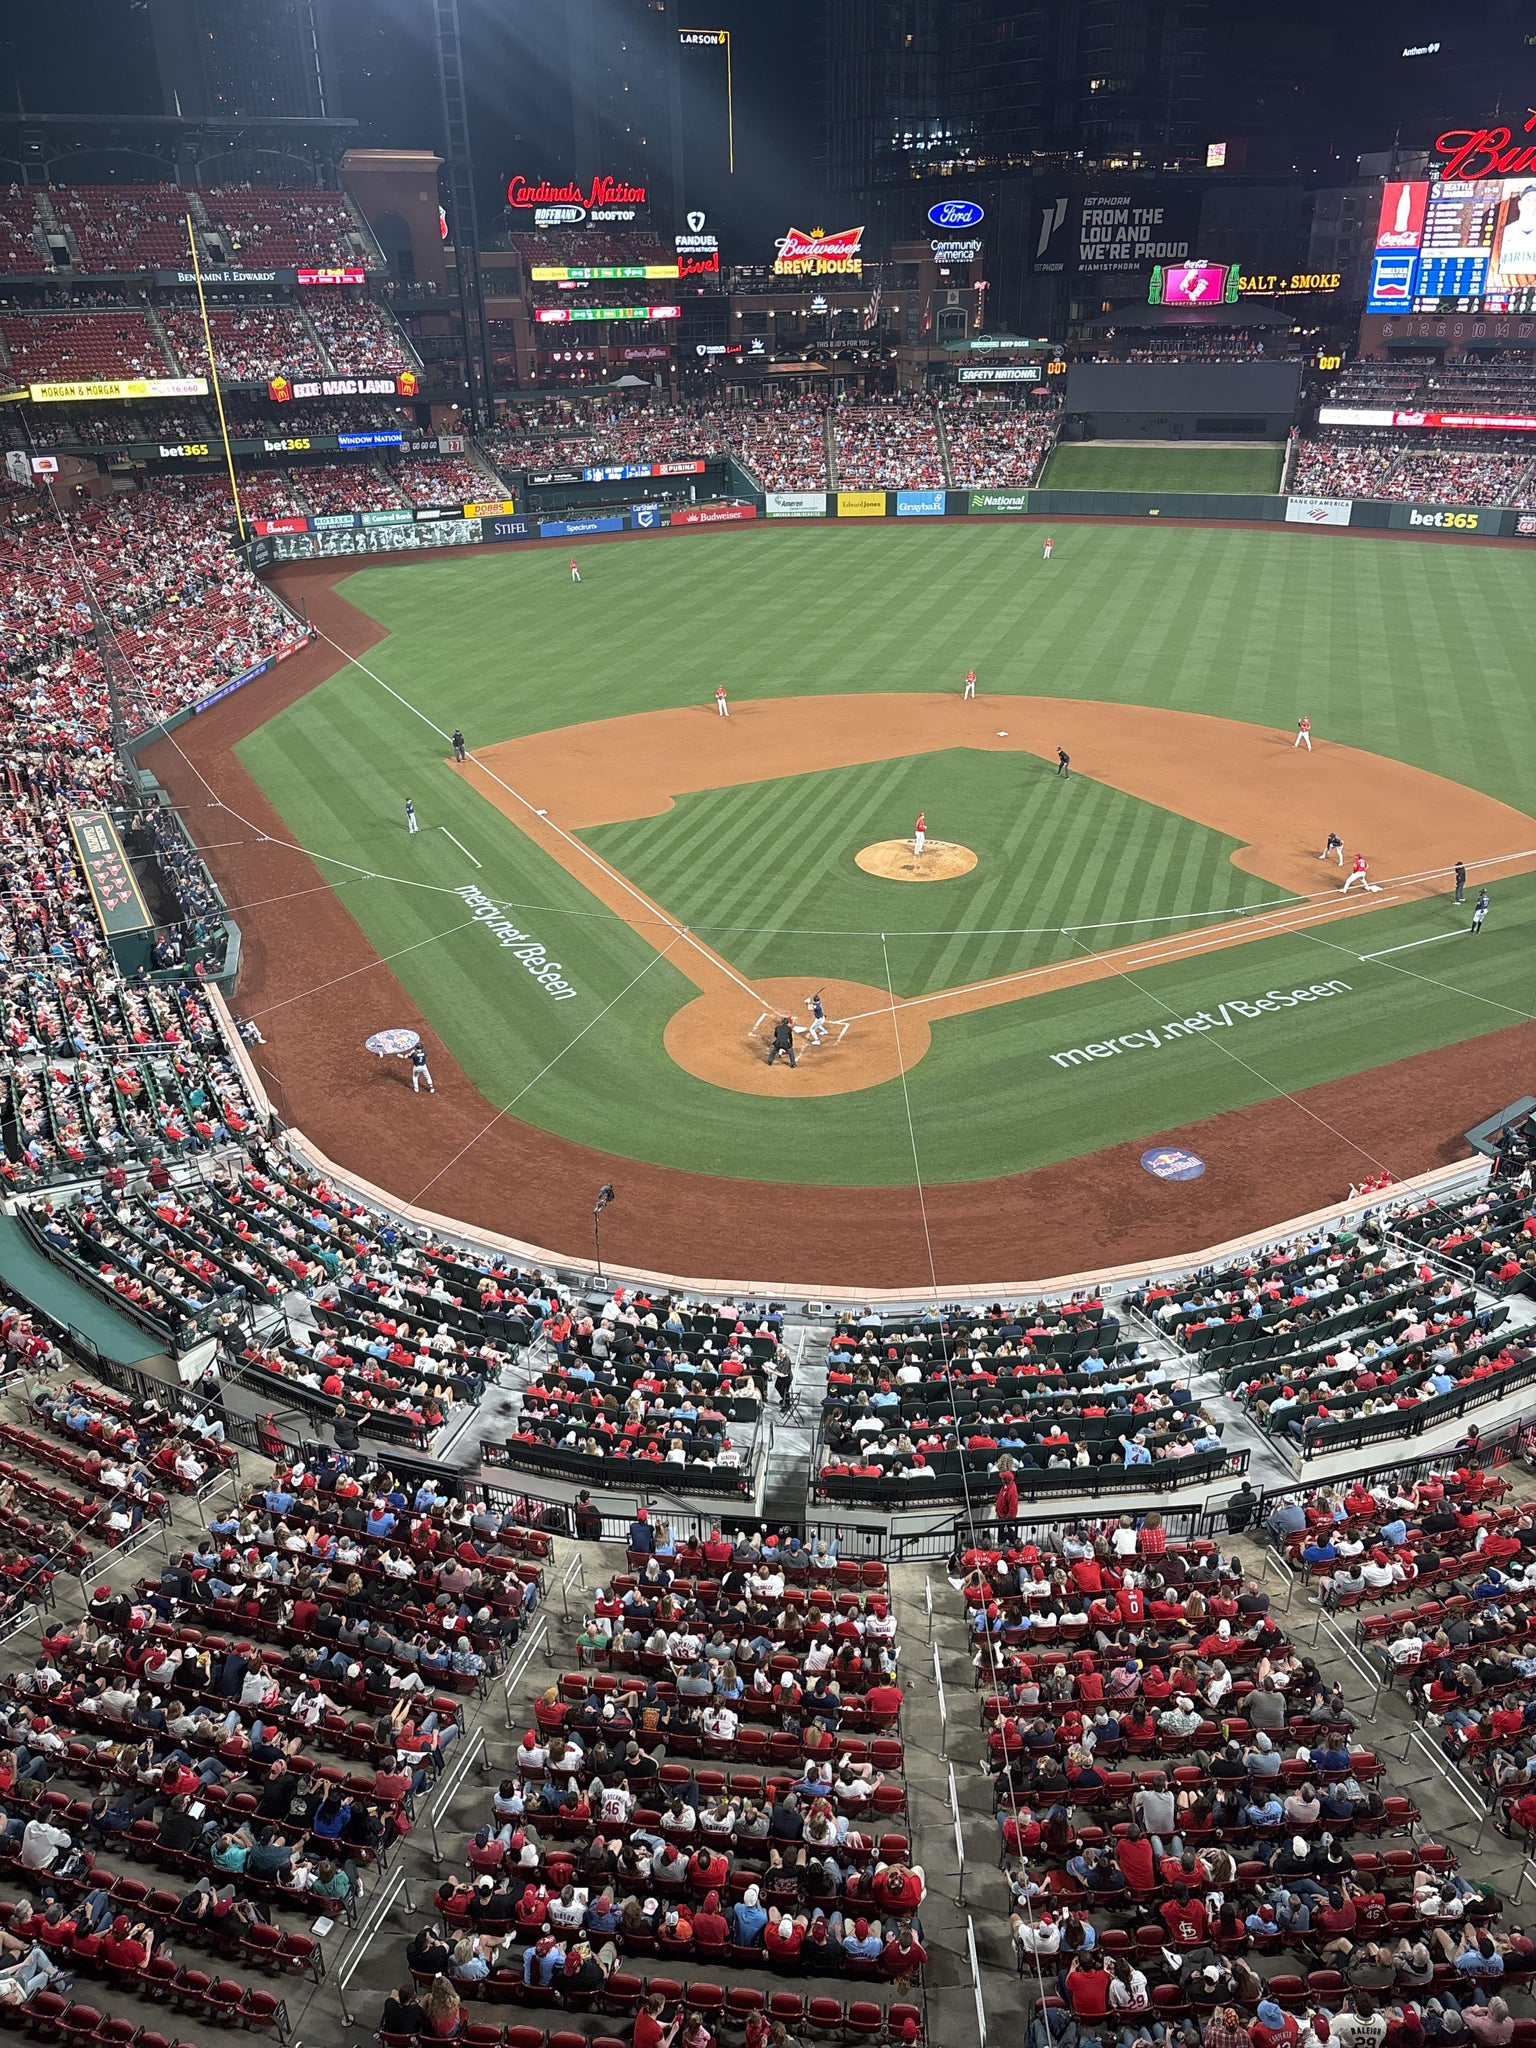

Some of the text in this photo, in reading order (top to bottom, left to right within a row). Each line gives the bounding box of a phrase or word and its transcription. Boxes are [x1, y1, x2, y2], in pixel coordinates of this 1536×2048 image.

[680, 34, 718, 45] LARSON
[1402, 47, 1428, 57] Anthem
[507, 175, 646, 208] Cardinals Nation
[1443, 182, 1475, 191] SEATTLE
[535, 208, 577, 220] HOFFMANN
[591, 211, 636, 221] ROOFTOP
[940, 203, 973, 223] Ford
[1082, 208, 1164, 226] FROM THE
[1081, 226, 1150, 243] LOU AND
[675, 236, 718, 246] FANDUEL
[931, 239, 982, 252] Community
[774, 237, 861, 258] Budweiser
[1080, 242, 1188, 260] WE'RE PROUD
[677, 252, 720, 278] Live!
[774, 259, 862, 275] BREW HOUSE
[1078, 263, 1140, 271] #IAM1STPHORM
[178, 272, 274, 282] BENAMIN F. EDWARDS
[1238, 274, 1340, 290] SALT + SMOKE
[1420, 323, 1429, 337] 2
[1436, 323, 1446, 337] 6
[1454, 323, 1464, 337] 9
[1472, 323, 1486, 337] 10
[1495, 323, 1509, 337] 14
[962, 368, 1037, 380] SAFETY NATIONAL
[41, 386, 76, 397] MORGAN
[79, 386, 83, 394] &
[86, 385, 120, 395] MORGAN
[323, 381, 356, 396] MAC
[358, 380, 395, 394] LAND
[264, 438, 311, 452] bet365
[339, 434, 402, 445] WINDOW NATION
[159, 444, 209, 457] bet365
[668, 464, 696, 472] PURINA
[781, 500, 804, 508] Ameren
[984, 496, 1024, 507] National
[1319, 500, 1350, 508] AMERICA
[474, 504, 504, 512] DOBBS
[372, 513, 401, 523] Central
[700, 513, 742, 522] Budweiser
[1410, 509, 1479, 529] bet365
[495, 522, 528, 535] STIFEL
[566, 524, 597, 533] Spectrum
[454, 884, 577, 1001] mercy.net/BeSeen
[1050, 979, 1353, 1068] mercy.net/BeSeen
[1131, 1601, 1138, 1613] 0
[1408, 1652, 1419, 1662] 15
[712, 1721, 720, 1733] 4
[605, 1801, 619, 1815] 46
[1128, 1995, 1145, 2009] 29
[1351, 2027, 1382, 2036] RALEIGH
[1355, 2037, 1377, 2048] 29
